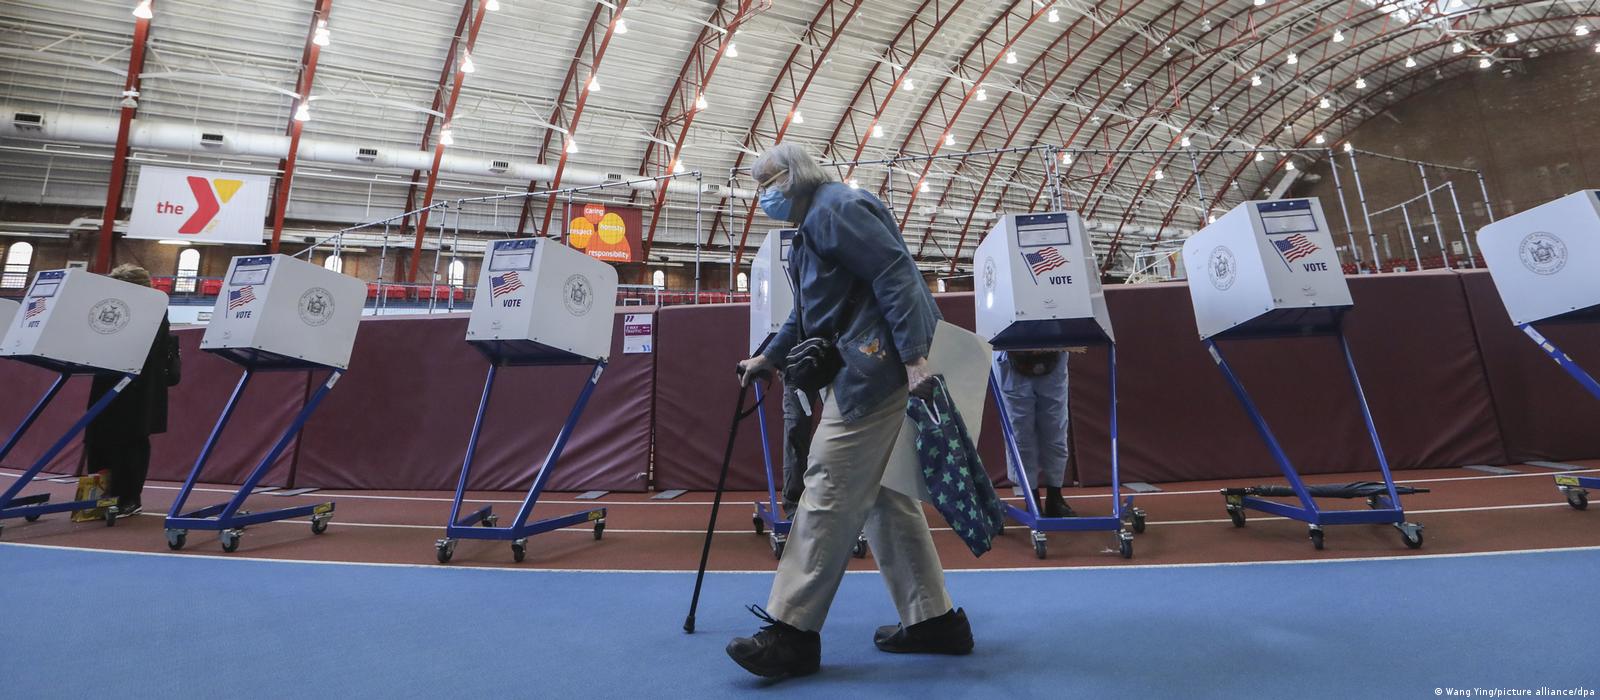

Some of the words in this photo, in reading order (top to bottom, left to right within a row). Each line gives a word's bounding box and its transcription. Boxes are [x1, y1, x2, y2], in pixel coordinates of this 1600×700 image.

[157, 201, 183, 215] the
[585, 207, 604, 216] caring
[588, 250, 629, 259] responsibility
[1303, 263, 1327, 272] VOTE
[1049, 276, 1073, 285] VOTE
[503, 299, 521, 308] VOTE
[236, 311, 251, 319] VOTE
[28, 320, 40, 328] VOTE
